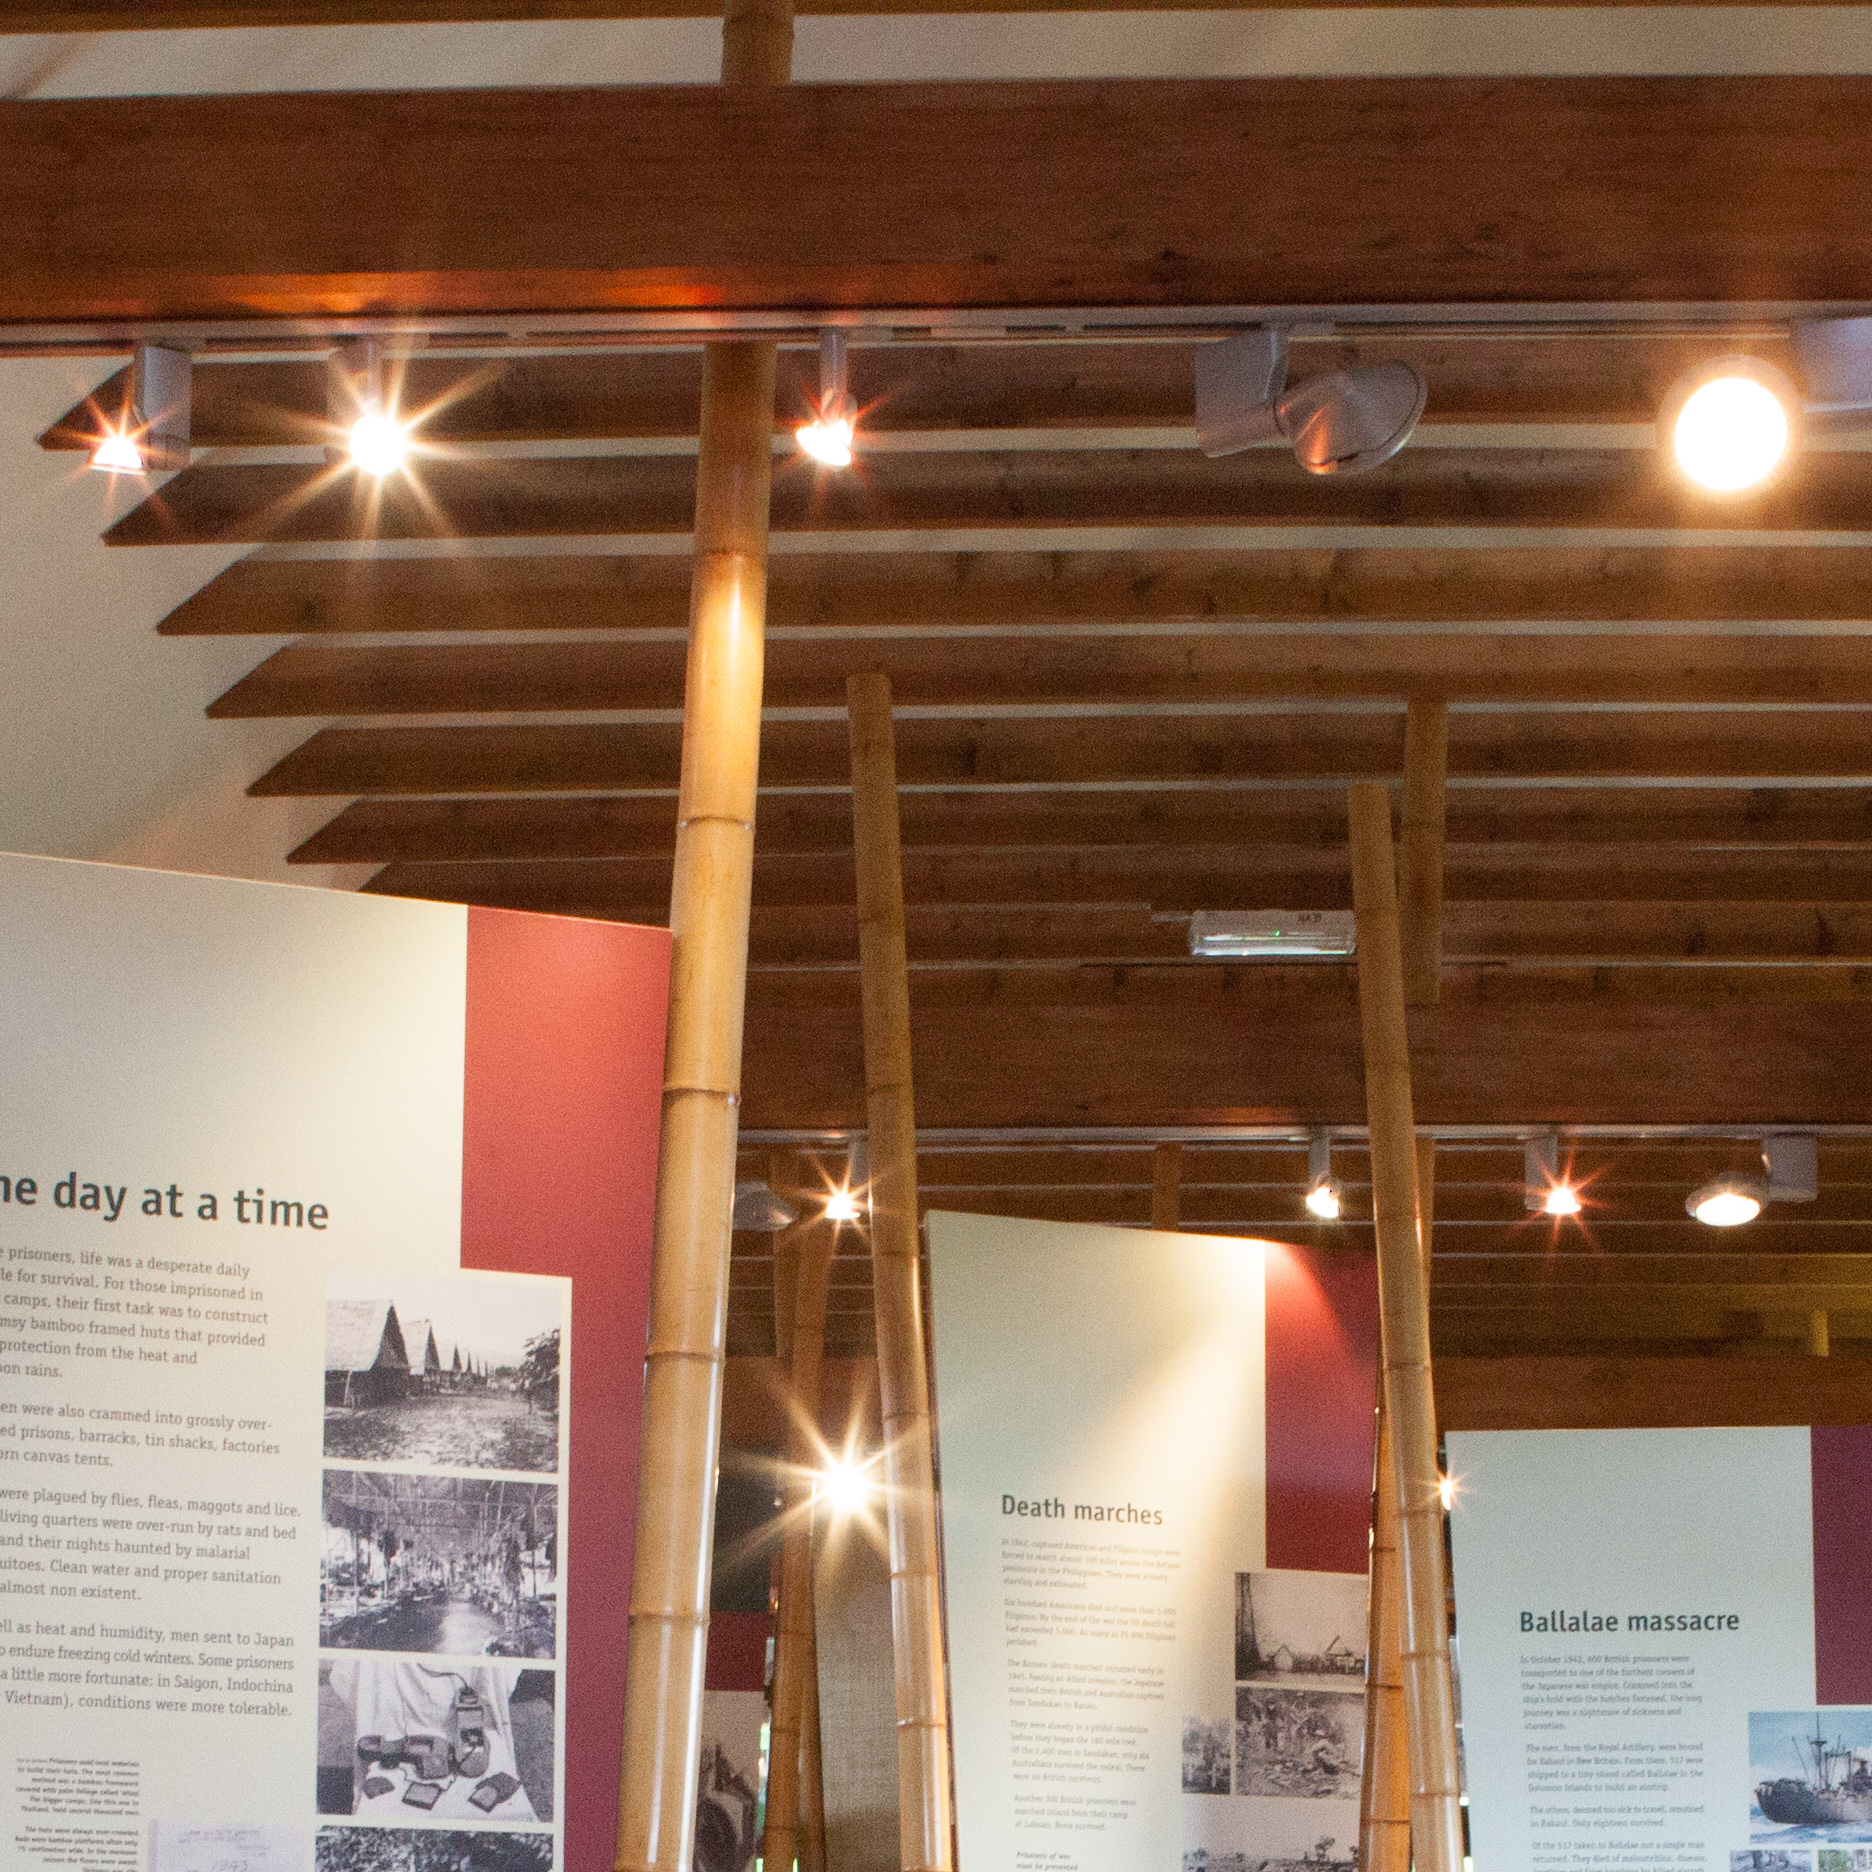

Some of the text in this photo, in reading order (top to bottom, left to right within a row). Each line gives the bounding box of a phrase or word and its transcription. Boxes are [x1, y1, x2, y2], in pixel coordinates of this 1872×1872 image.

[53, 1170, 127, 1223] day
[141, 1183, 183, 1219] at
[197, 1193, 218, 1221] a
[234, 1187, 329, 1231] time
[7, 1246, 75, 1265] prisoners,
[79, 1250, 104, 1266] life
[106, 1255, 133, 1269] was
[135, 1258, 144, 1269] a
[146, 1256, 213, 1275] desperate
[215, 1261, 250, 1281] daily
[16, 1267, 37, 1284] for
[40, 1272, 99, 1289] survival.
[103, 1274, 125, 1291] For
[128, 1277, 167, 1294] those
[170, 1281, 246, 1301] imprisoned
[249, 1289, 264, 1301] in
[2, 1293, 51, 1310] camps,
[54, 1294, 89, 1311] their
[92, 1296, 122, 1314] first
[124, 1301, 155, 1316] task
[158, 1305, 184, 1319] was
[186, 1306, 202, 1320] to
[204, 1309, 269, 1325] construct
[29, 1315, 86, 1334] bamboo
[88, 1319, 137, 1338] framed
[139, 1324, 171, 1340] huts
[173, 1326, 203, 1343] that
[206, 1332, 266, 1350] provided
[74, 1341, 108, 1358] from
[110, 1345, 135, 1361] the
[137, 1346, 169, 1363] heat
[172, 1351, 198, 1365] and
[24, 1363, 62, 1378] rains.
[1001, 1493, 1163, 1526] Death marches
[1520, 1609, 1740, 1633] Ballalae massacre
